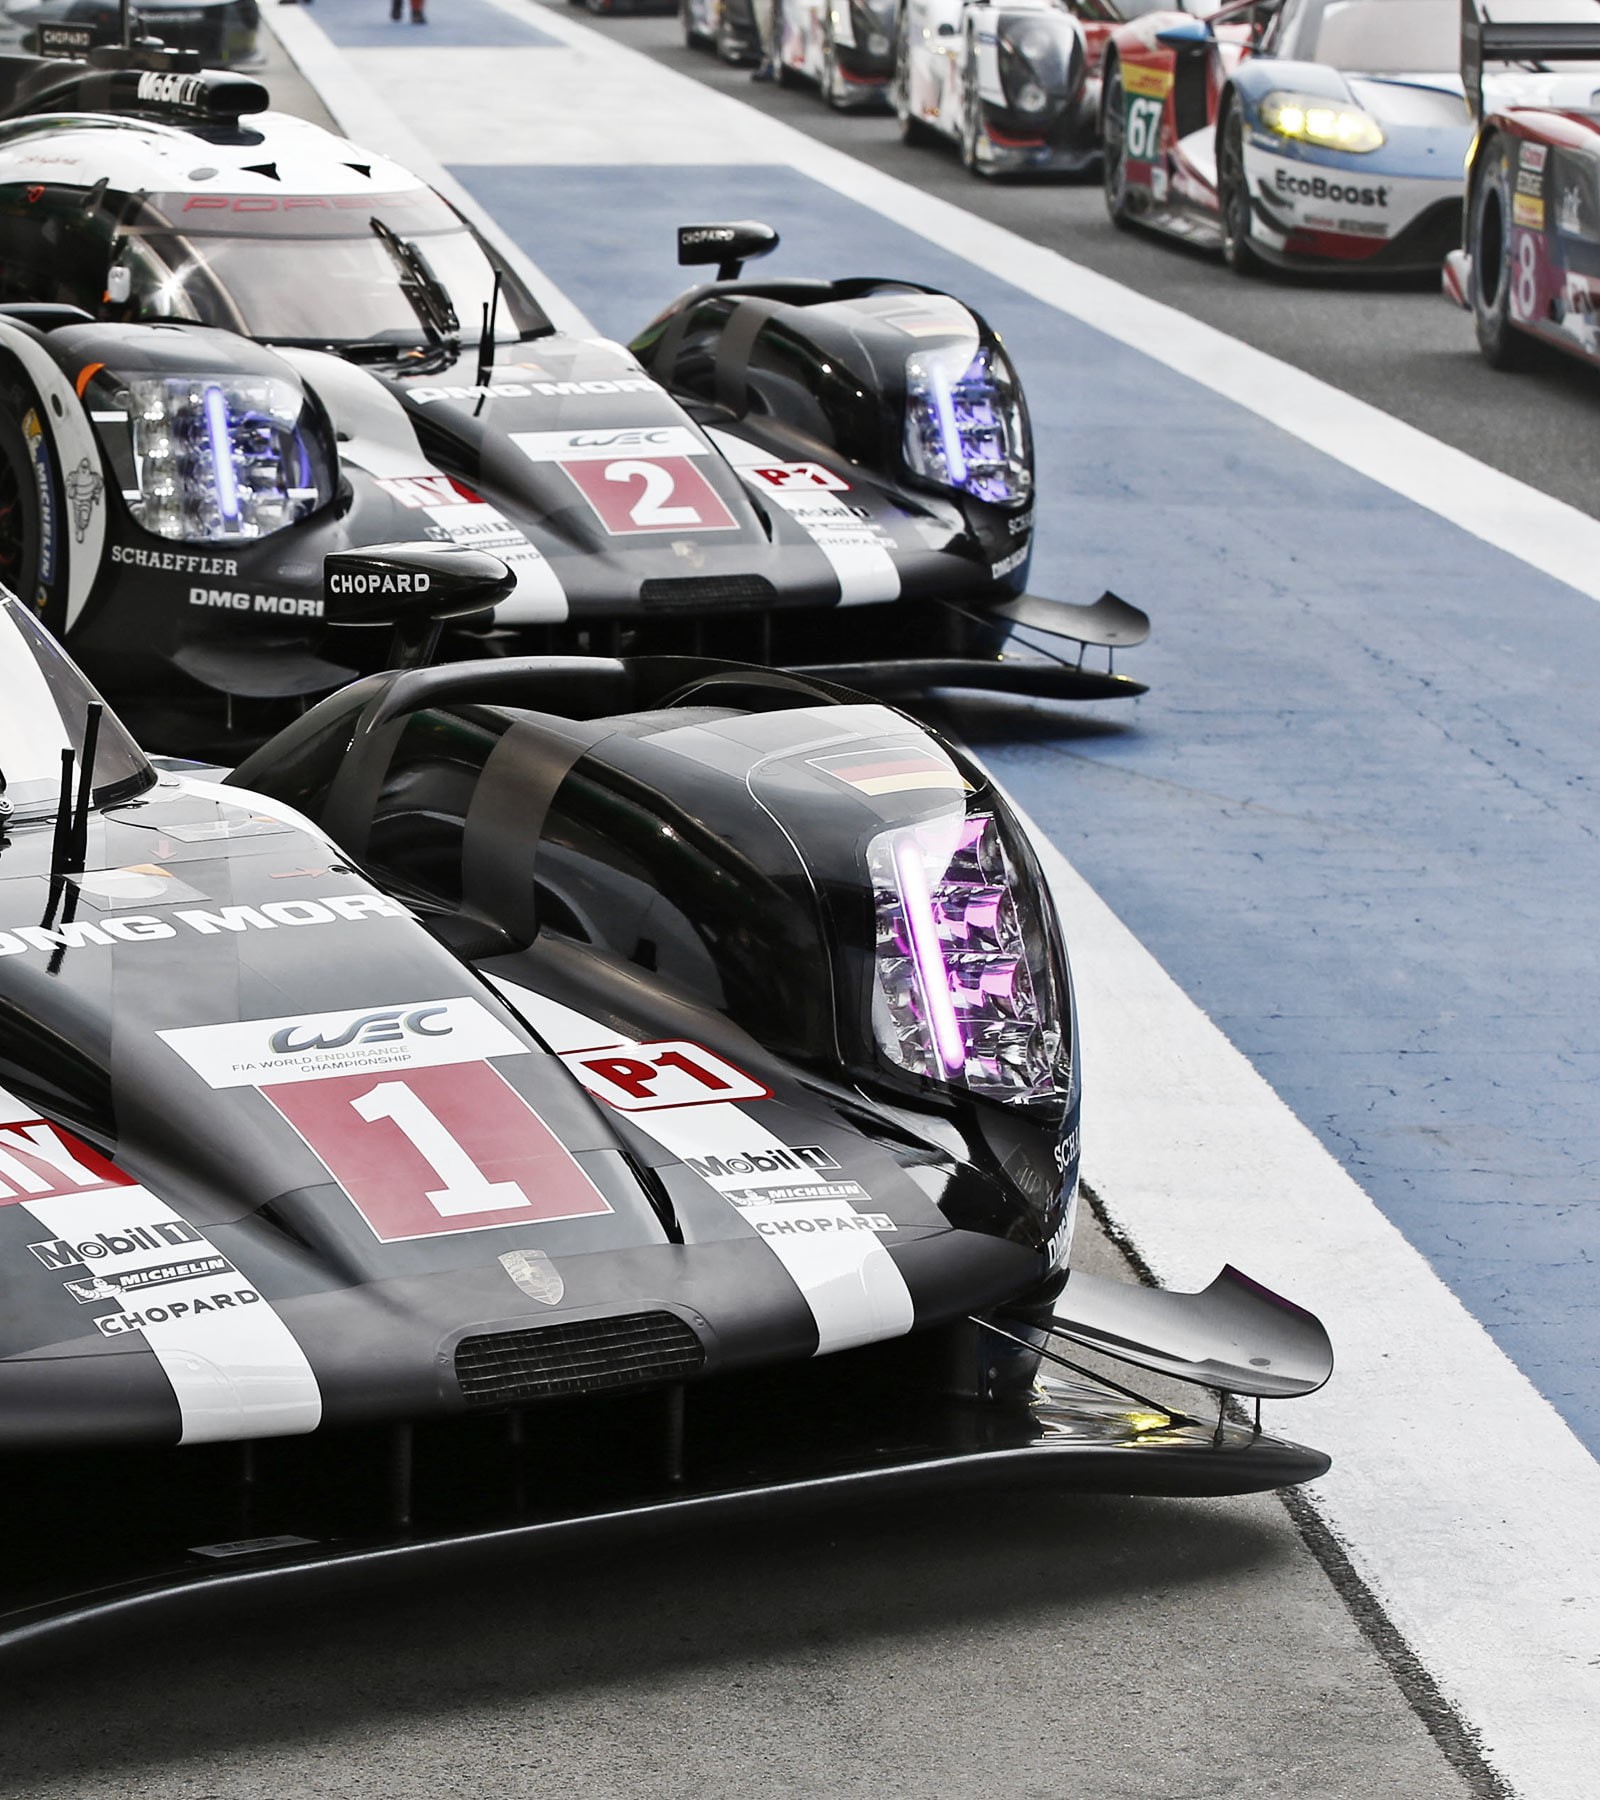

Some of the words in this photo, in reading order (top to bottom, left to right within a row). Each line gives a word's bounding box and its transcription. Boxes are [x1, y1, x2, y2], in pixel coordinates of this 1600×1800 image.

[43, 30, 90, 46] CHOPARD
[138, 71, 184, 103] Mobil
[1128, 97, 1163, 158] 67
[1275, 169, 1389, 207] EcoBoost
[183, 195, 415, 212] PORSC
[681, 228, 734, 246] CHOPARD
[1517, 232, 1537, 318] 8
[406, 383, 532, 405] DMG
[532, 379, 662, 396] MOR
[568, 430, 670, 448] WEC
[377, 477, 469, 507] HY
[756, 467, 829, 488] P1
[604, 460, 703, 527] 2
[35, 460, 53, 578] MICHELIN
[111, 545, 239, 576] SCHAEFFLER
[330, 572, 431, 595] CHOPARD
[190, 588, 250, 611] DMG
[253, 595, 324, 617] MORI
[186, 894, 403, 935] MOR
[268, 1007, 453, 1054] WEC
[232, 1063, 257, 1073] FIA
[259, 1057, 312, 1070] WORLD
[314, 1045, 410, 1063] ENDURANCE
[300, 1054, 413, 1074] CHAMPIONSHIP
[579, 1051, 734, 1099] P1
[350, 1080, 533, 1218] 1
[684, 1149, 802, 1178] Mobil
[768, 1185, 861, 1201] MICHELIN
[755, 1216, 893, 1236] CHOPARD
[31, 1225, 163, 1269] Mobil
[118, 1257, 227, 1287] MICHELIN
[99, 1289, 260, 1334] CHOPARD
